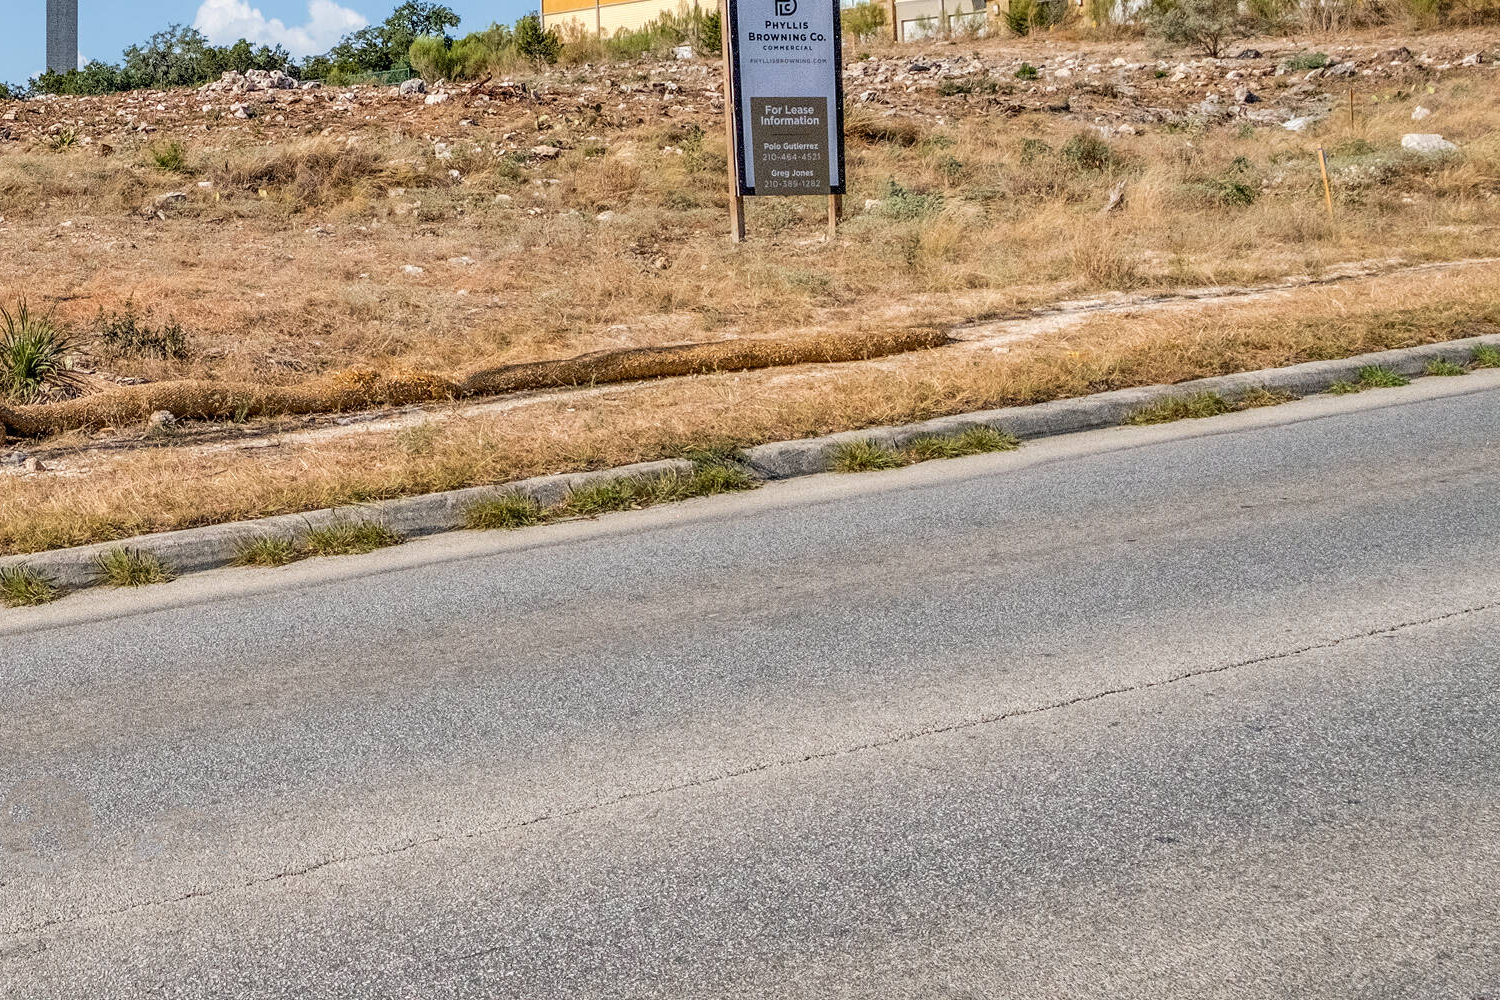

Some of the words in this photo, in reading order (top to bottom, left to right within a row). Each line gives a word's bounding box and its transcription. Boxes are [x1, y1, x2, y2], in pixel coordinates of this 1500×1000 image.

[765, 105, 782, 115] For
[785, 105, 814, 115] Lease
[761, 116, 820, 126] Information
[764, 142, 781, 150] Polo
[783, 142, 819, 150] Gutierrez
[771, 169, 790, 178] Greg
[792, 169, 814, 177] Jones
